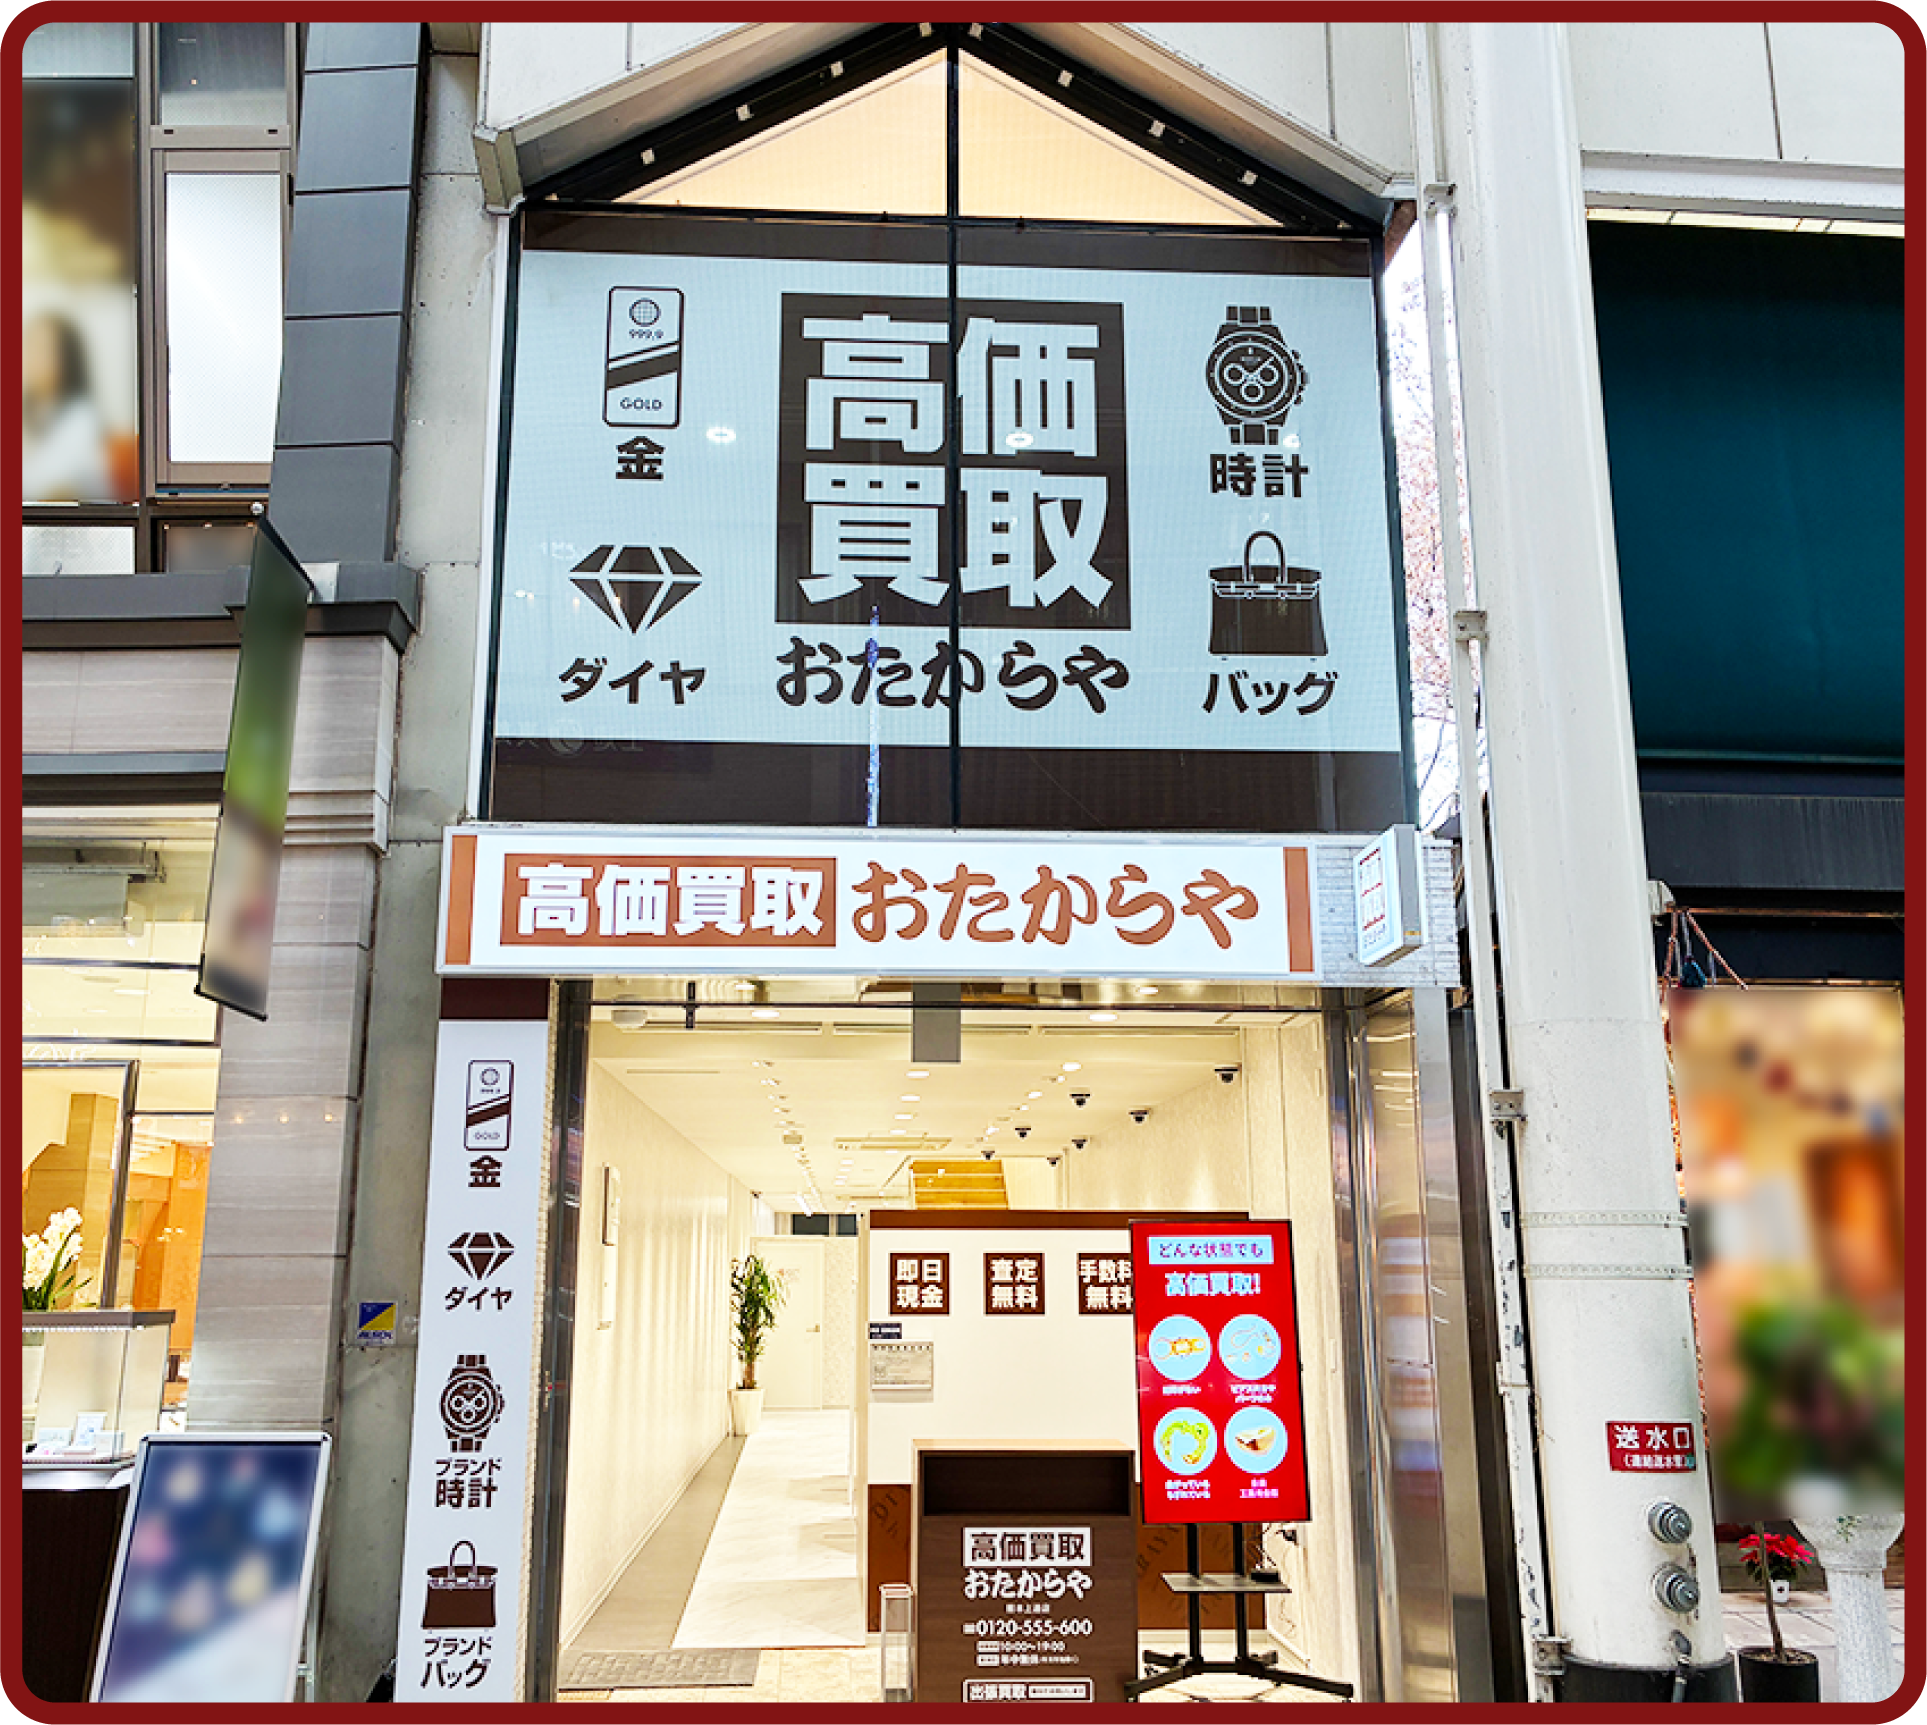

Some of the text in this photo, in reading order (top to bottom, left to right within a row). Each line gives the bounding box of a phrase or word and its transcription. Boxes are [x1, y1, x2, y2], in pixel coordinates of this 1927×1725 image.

[803, 312, 1100, 457] 高価
[620, 396, 662, 411] GOLD
[615, 435, 665, 480] 金
[1209, 452, 1309, 498] 時計
[799, 463, 1114, 609] 買取
[559, 656, 707, 705] ダイヤ
[776, 635, 1130, 714] おたからや
[1202, 670, 1339, 716] バッグ
[517, 860, 825, 937] 高価買取
[851, 860, 1259, 950] おたからや
[467, 1154, 503, 1188] 金
[895, 1258, 943, 1284] 即日
[990, 1257, 1039, 1282] 査定
[445, 1285, 513, 1312] ダイヤ
[896, 1284, 944, 1309] 現金
[991, 1284, 1039, 1309] 無料
[1084, 1285, 1134, 1311] 無料
[1613, 1425, 1691, 1451] 送水口
[435, 1457, 502, 1476] ブランド
[435, 1477, 499, 1509] 時計
[970, 1531, 1085, 1562] 高価買取
[964, 1567, 1093, 1600] おたからや
[976, 1618, 1093, 1637] 0120-555-600
[424, 1636, 492, 1657] ブランド
[420, 1657, 492, 1689] バッグ
